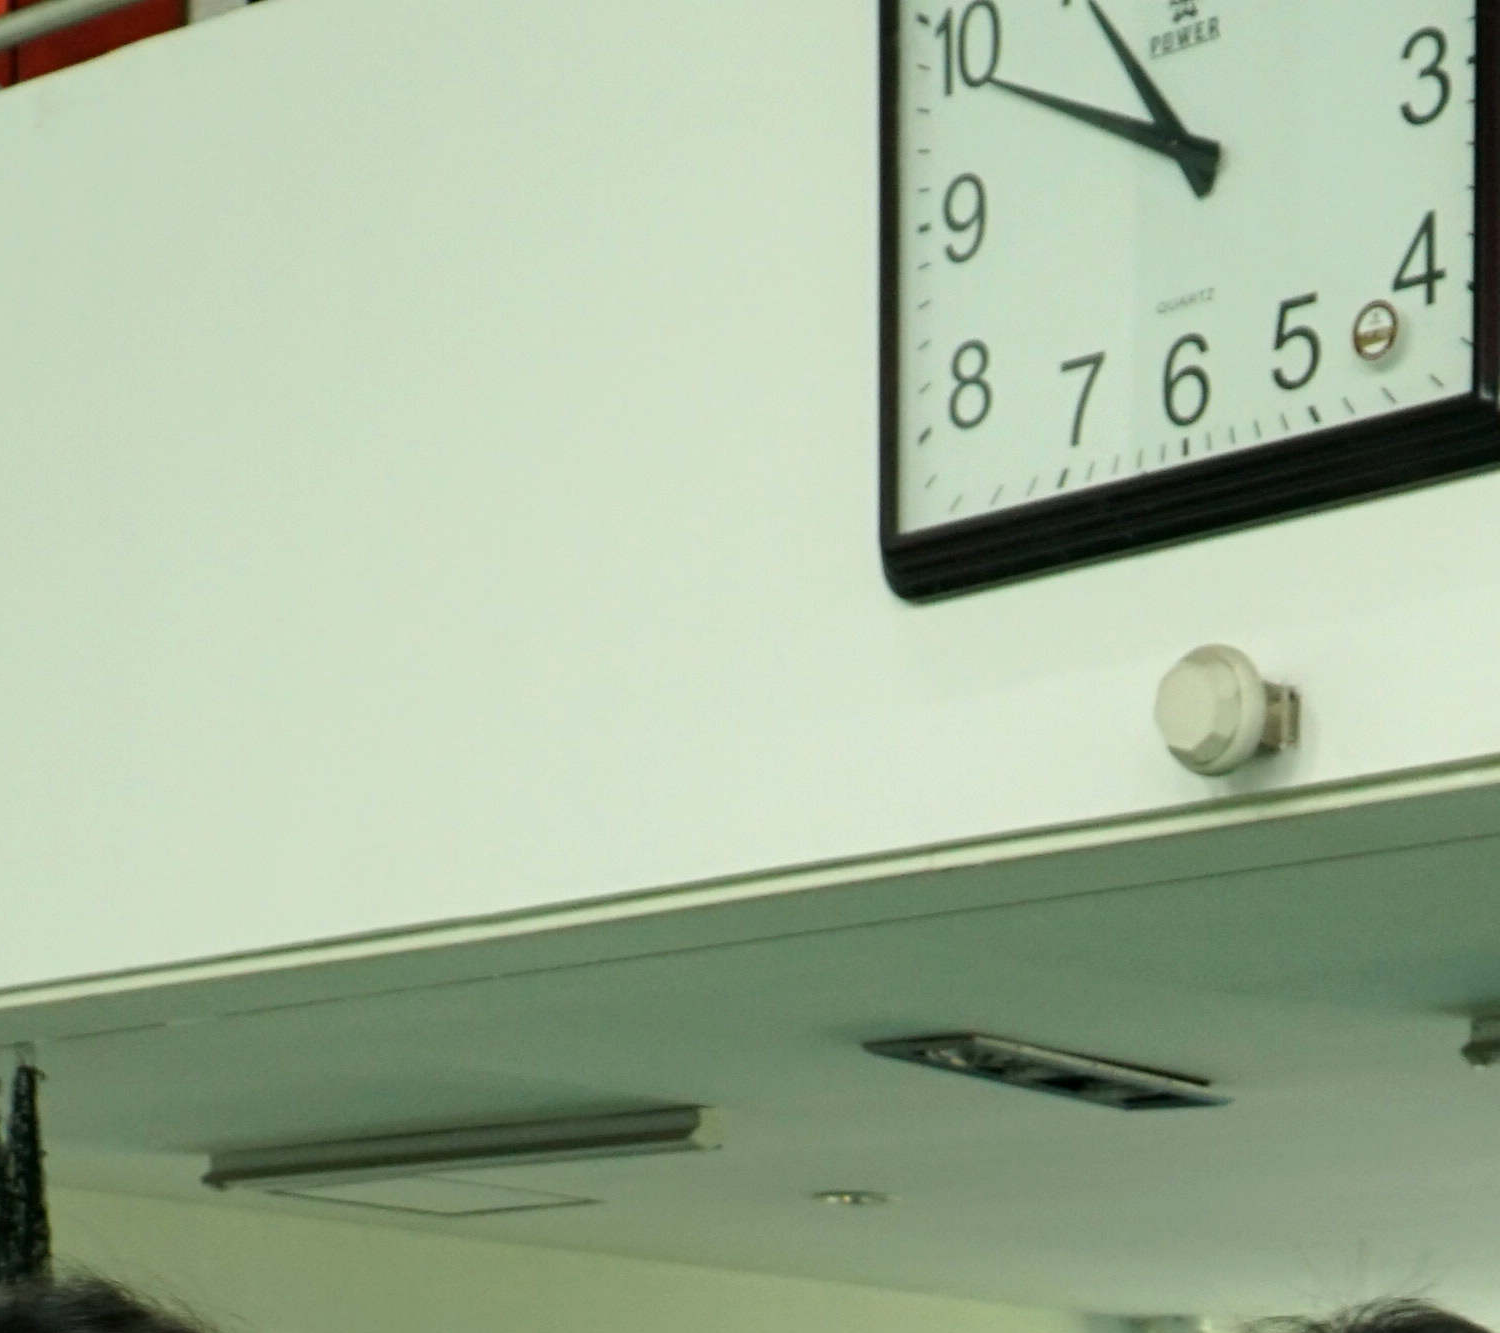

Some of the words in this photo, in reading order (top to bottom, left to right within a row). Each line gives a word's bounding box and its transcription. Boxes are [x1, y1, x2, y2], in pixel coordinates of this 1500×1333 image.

[934, 0, 999, 96] 10
[1400, 26, 1451, 126] 3
[942, 172, 987, 264] 9
[1392, 209, 1446, 305] 4
[949, 339, 992, 431] 8
[1162, 333, 1211, 427] 6
[1271, 292, 1321, 391] 5
[1059, 351, 1106, 447] 7
